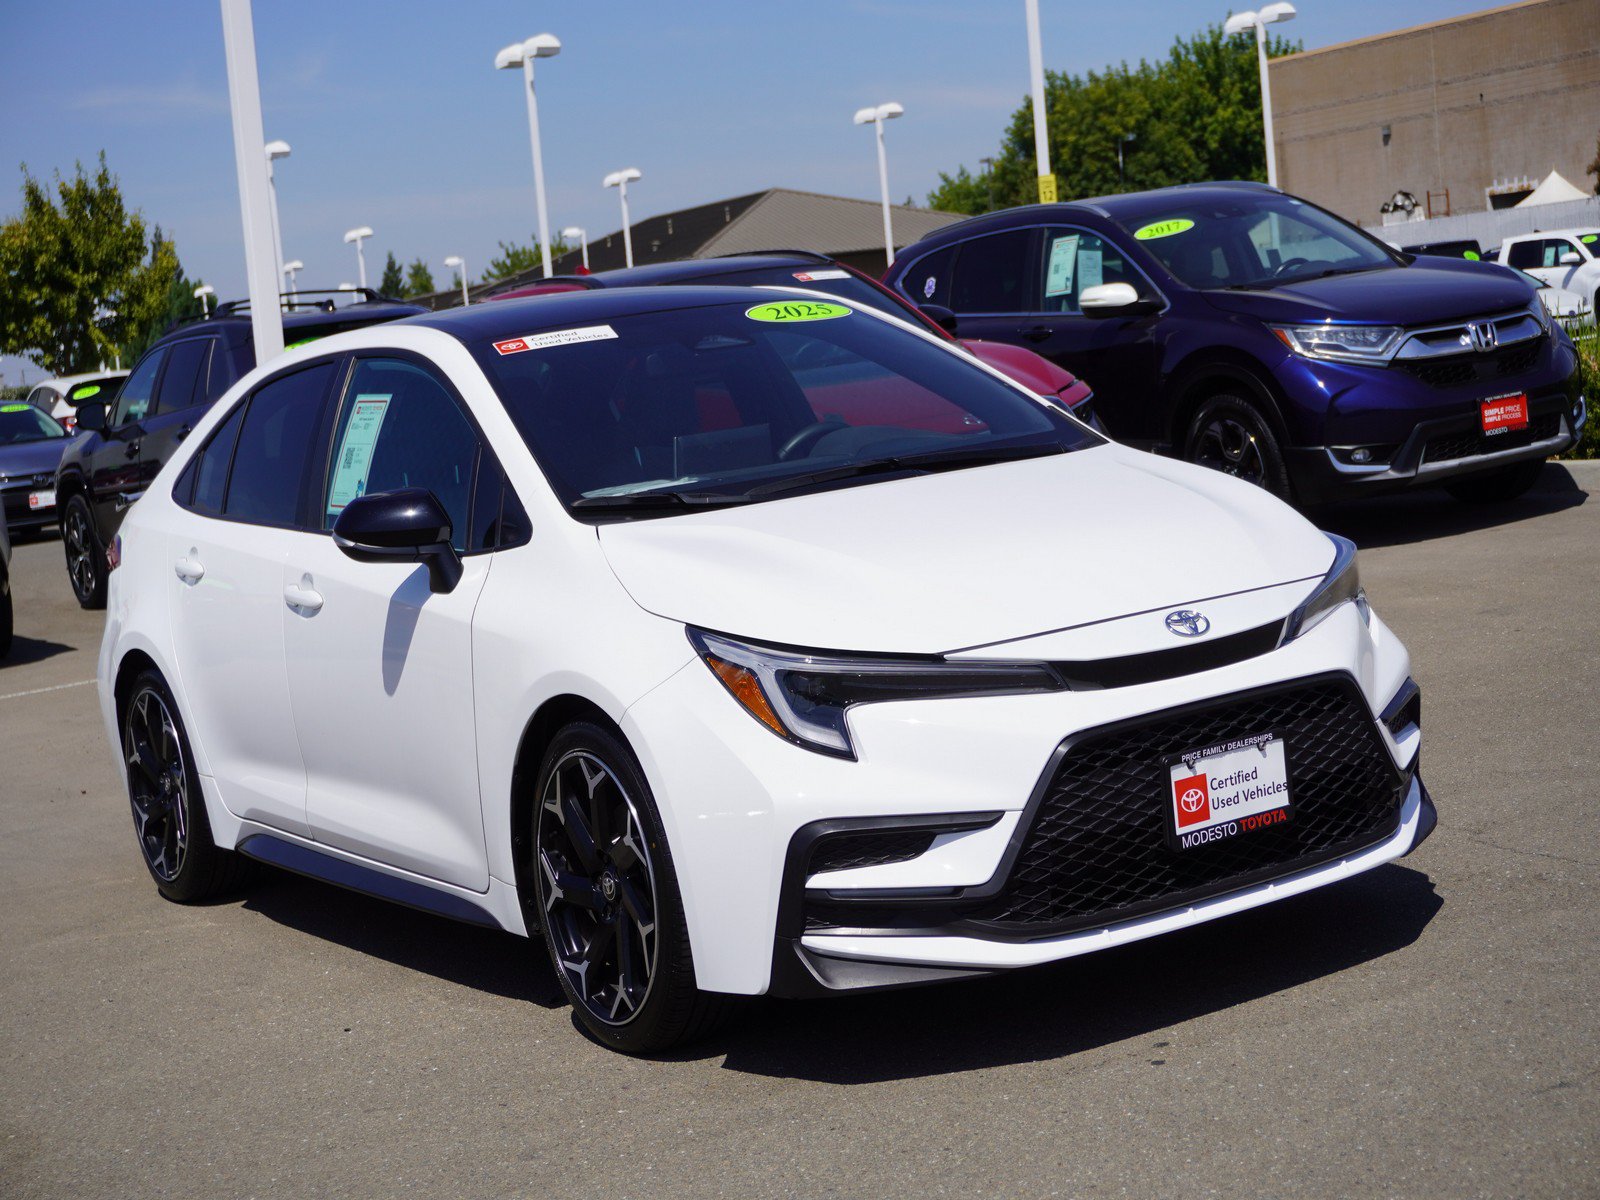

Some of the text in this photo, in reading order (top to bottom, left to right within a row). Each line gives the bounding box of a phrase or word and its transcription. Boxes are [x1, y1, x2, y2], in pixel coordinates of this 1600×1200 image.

[1042, 190, 1054, 201] 12
[1146, 221, 1180, 237] 2017
[766, 304, 832, 320] 2025
[531, 331, 578, 341] Certified
[534, 333, 609, 347] Used Vehicles
[1484, 407, 1504, 417] SIMPLE
[1485, 426, 1508, 437] MODESTO
[1181, 732, 1273, 763] PRICE FAMILY DEALERSHIPS
[1210, 766, 1258, 791] Certified
[1212, 781, 1288, 810] Used Vehicles
[1181, 809, 1287, 849] MODESTO TOYOTA
